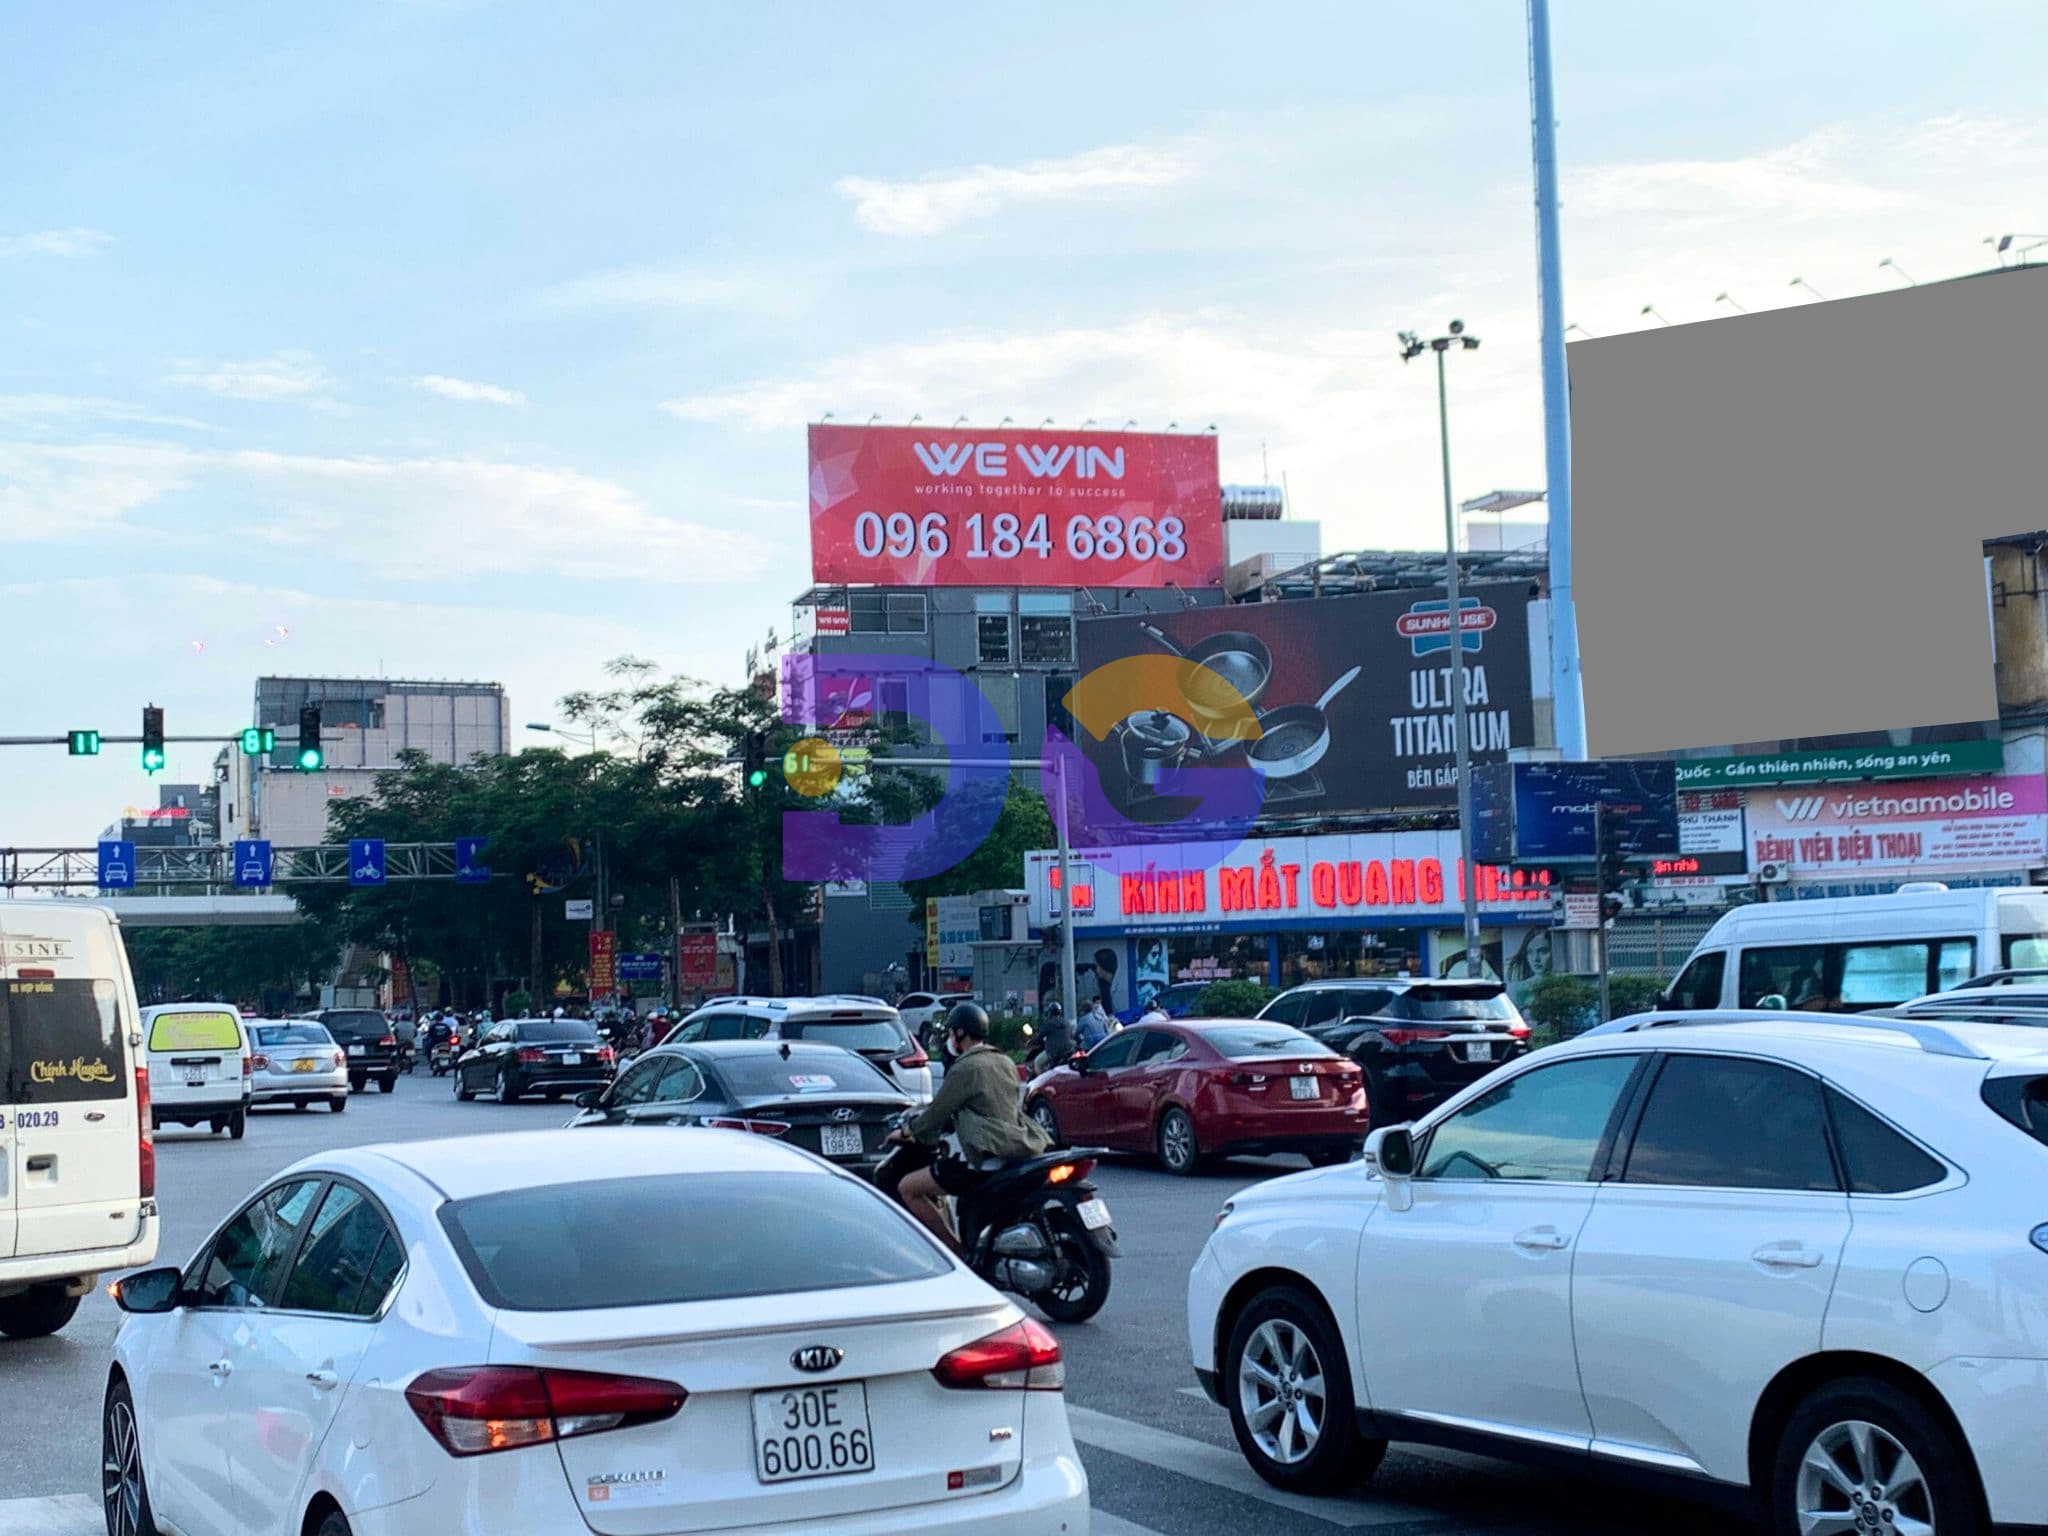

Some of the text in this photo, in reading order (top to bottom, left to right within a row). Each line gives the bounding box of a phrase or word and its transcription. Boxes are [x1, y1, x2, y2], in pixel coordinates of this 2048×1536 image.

[914, 442, 1125, 480] WE WIN
[914, 482, 1126, 498] working together to success
[854, 511, 1188, 562] 096 184 6868
[77, 732, 98, 753] 11
[1390, 709, 1511, 757] TITANUM
[783, 752, 809, 774] 61
[1758, 758, 1800, 775] thiên
[1802, 756, 1853, 773] nhiên,
[1856, 753, 1895, 770] sống
[1897, 755, 1918, 765] an
[1921, 751, 1951, 767] yên
[1830, 787, 2014, 819] vietnamobile
[1876, 831, 1922, 863] THOẠI
[1121, 861, 1206, 915] KÍNH
[1219, 848, 1300, 912] MẮT
[1312, 858, 1444, 908] QUANG
[17, 1111, 59, 1129] 020.29
[799, 1350, 837, 1368] KIA
[781, 1388, 842, 1431] 30E
[762, 1430, 868, 1476] 600.66
